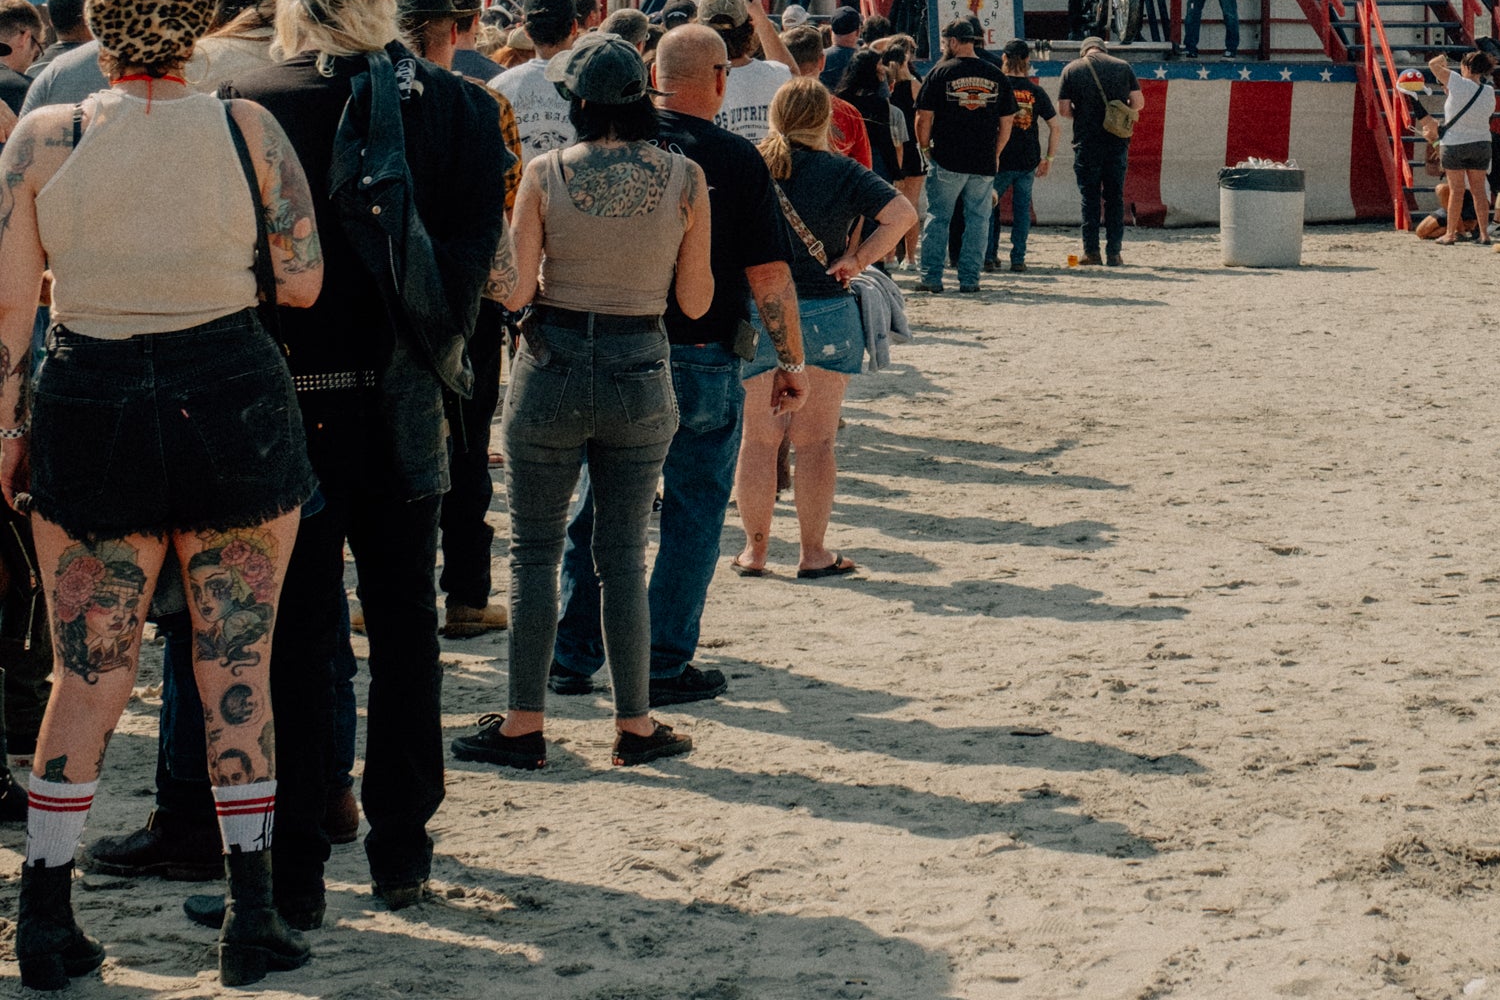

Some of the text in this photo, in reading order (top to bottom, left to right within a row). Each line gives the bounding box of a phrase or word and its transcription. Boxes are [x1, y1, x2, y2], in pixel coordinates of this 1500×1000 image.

[950, 0, 957, 10] 9
[993, 0, 1000, 10] 3
[991, 11, 997, 19] 4
[984, 18, 990, 27] 5
[730, 105, 769, 125] NUTRIT
